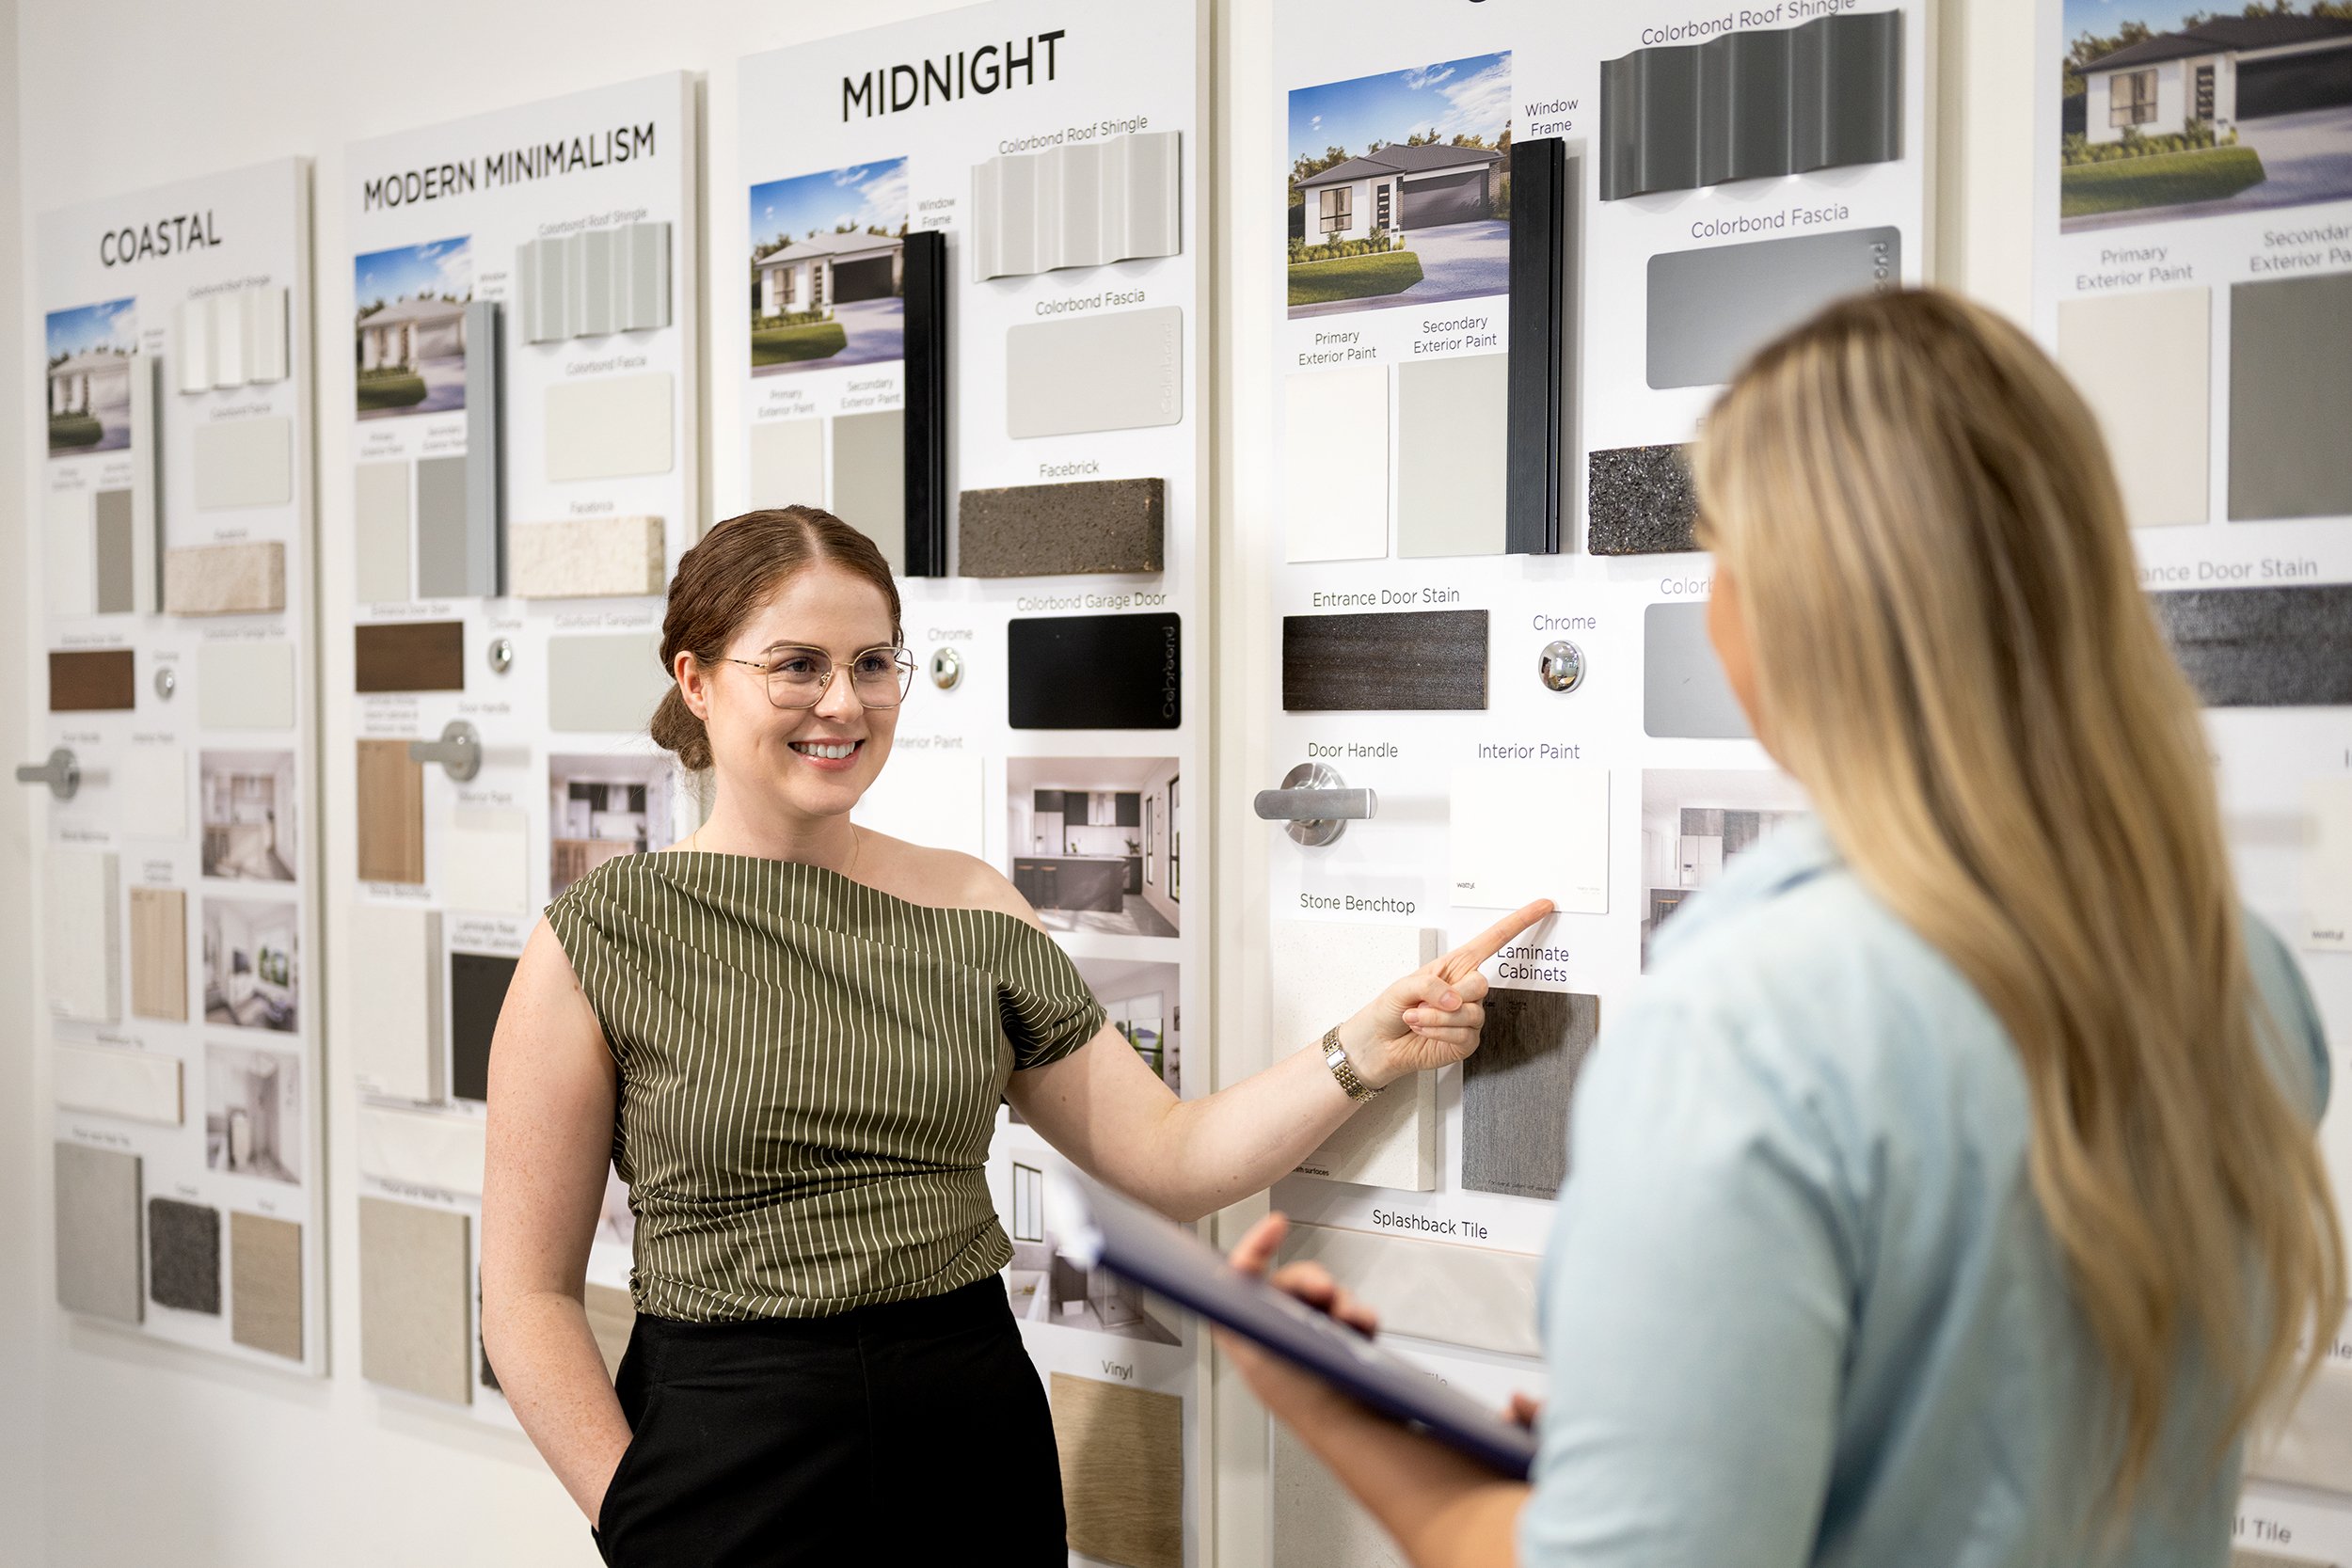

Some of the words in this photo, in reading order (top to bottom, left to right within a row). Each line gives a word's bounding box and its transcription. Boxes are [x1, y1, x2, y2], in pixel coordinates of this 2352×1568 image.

[1642, 12, 1733, 45] Colorbond
[1740, 5, 1783, 28] Roof
[1788, 0, 1855, 19] Shingle
[842, 28, 1066, 123] MIDNIGHT
[1525, 98, 1579, 118] Window
[998, 130, 1064, 155] Colorbond
[1066, 122, 1098, 143] Roof
[1100, 114, 1149, 137] Shingle
[1531, 119, 1572, 136] Frame
[363, 157, 476, 214] MODERN
[484, 120, 657, 190] MINIMALISM
[917, 196, 957, 213] Window
[922, 214, 952, 227] Frame
[1691, 210, 1785, 239] Colorbond
[1791, 203, 1850, 226] Fascia
[100, 209, 222, 268] COASTAL
[2264, 225, 2352, 247] Secondar
[2100, 245, 2168, 266] Primary
[2249, 251, 2322, 273] Exterior
[2075, 272, 2143, 291] Exterior
[2150, 264, 2194, 284] Paint
[1035, 293, 1102, 316] Colorbond
[1104, 289, 1146, 308] Fascia
[1422, 316, 1488, 335] Secondary
[1314, 331, 1360, 346] Primary
[1414, 337, 1462, 355] Exterior
[1466, 333, 1497, 349] Paint
[1298, 349, 1344, 366] Exterior
[1347, 346, 1377, 361] Paint
[1039, 460, 1100, 478] Facebrick
[2198, 561, 2253, 580] Door
[2260, 558, 2319, 578] Stain
[1017, 593, 1082, 611] Colorbond
[1085, 593, 1130, 610] Garage
[1134, 591, 1168, 607] Door
[1313, 590, 1376, 608] Entrance
[1381, 589, 1418, 605] Door
[1422, 587, 1460, 604] Stain
[1533, 614, 1597, 631] Chrome
[928, 627, 973, 642] Chrome
[1162, 626, 1176, 719] Colorbond
[1309, 742, 1343, 757] Door
[1348, 742, 1399, 758] Handle
[1478, 743, 1534, 759] Interior
[1539, 743, 1581, 759] Paint
[1300, 893, 1341, 911] Stone
[1345, 895, 1416, 915] Benchtop
[1497, 943, 1569, 962] Laminate
[1498, 962, 1567, 982] Cabinets
[1373, 1209, 1456, 1235] Splashback
[1461, 1221, 1488, 1240] Tile
[1101, 1360, 1134, 1380] Vinyl
[2253, 1518, 2292, 1544] Tile
